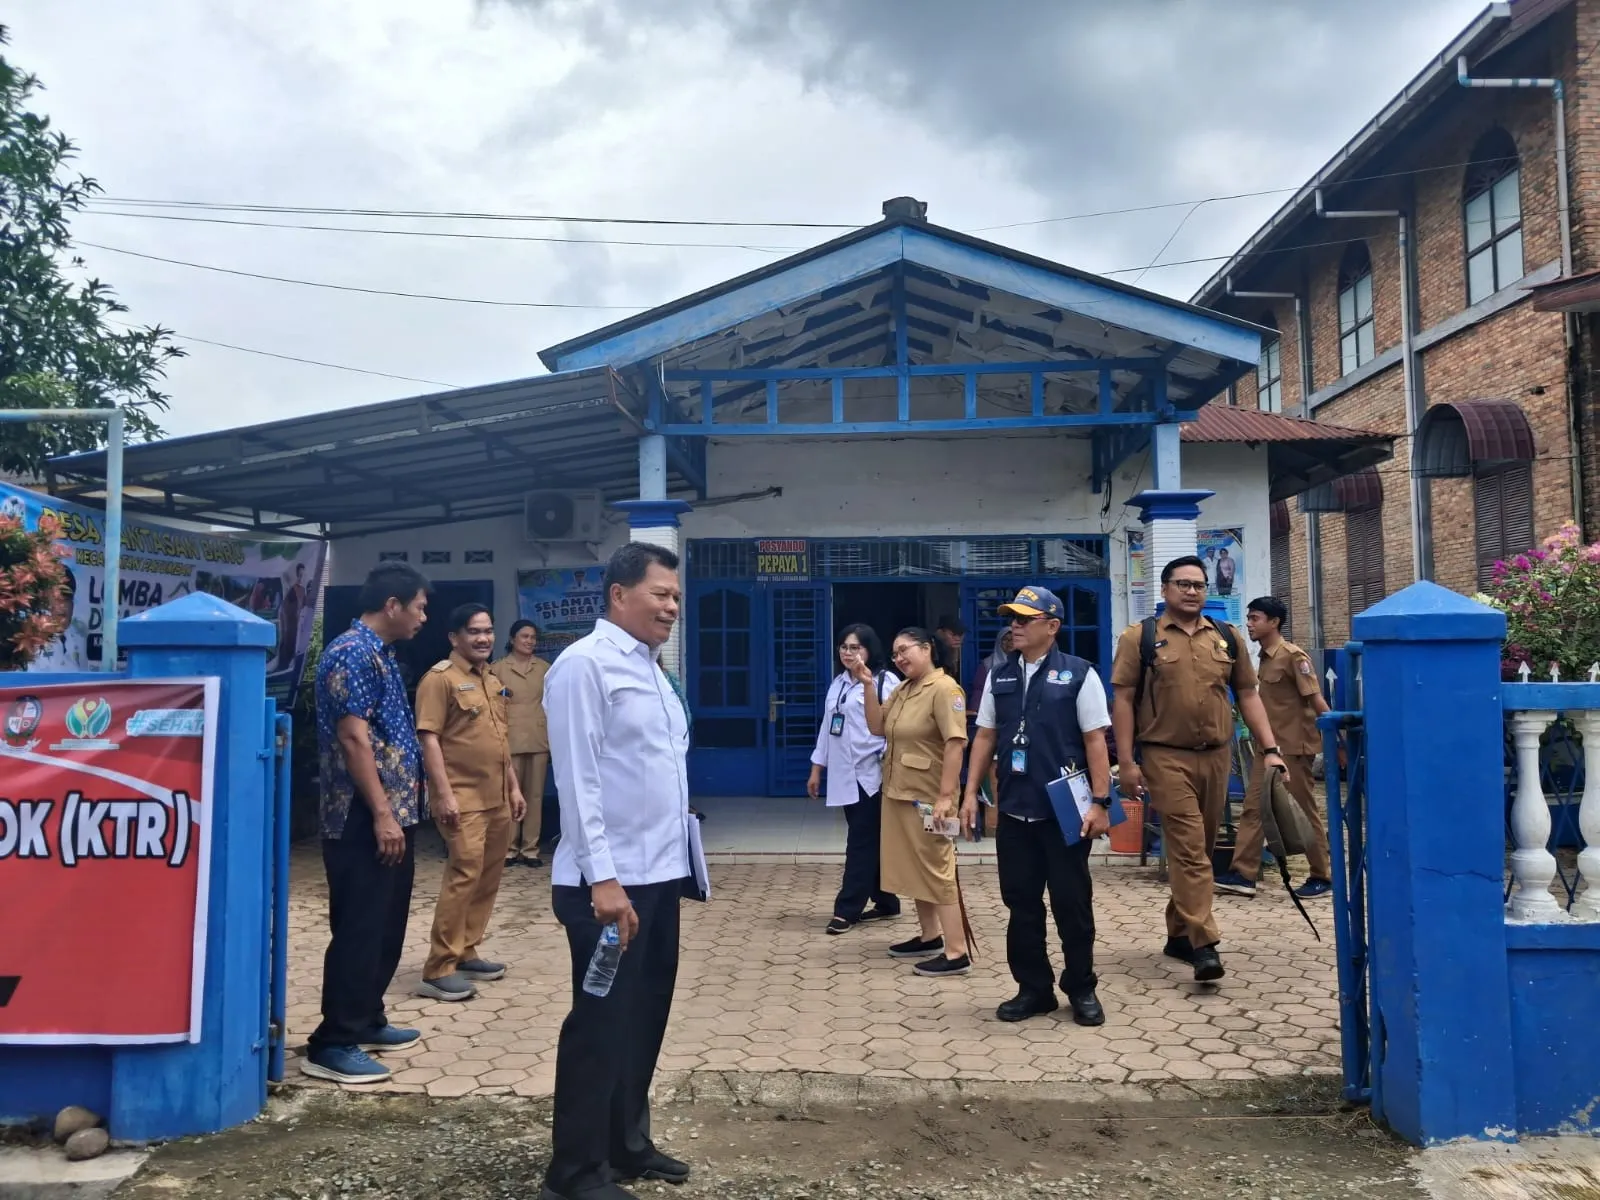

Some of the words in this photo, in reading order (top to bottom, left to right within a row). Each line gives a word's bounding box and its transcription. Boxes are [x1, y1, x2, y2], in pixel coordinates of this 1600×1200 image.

[757, 554, 798, 573] PEPAYA
[801, 554, 807, 573] 1
[89, 575, 162, 607] LMBA
[535, 597, 599, 612] SELAMAT
[543, 610, 556, 619] DI
[560, 606, 594, 616] DESA
[59, 790, 191, 867] (KTR)
